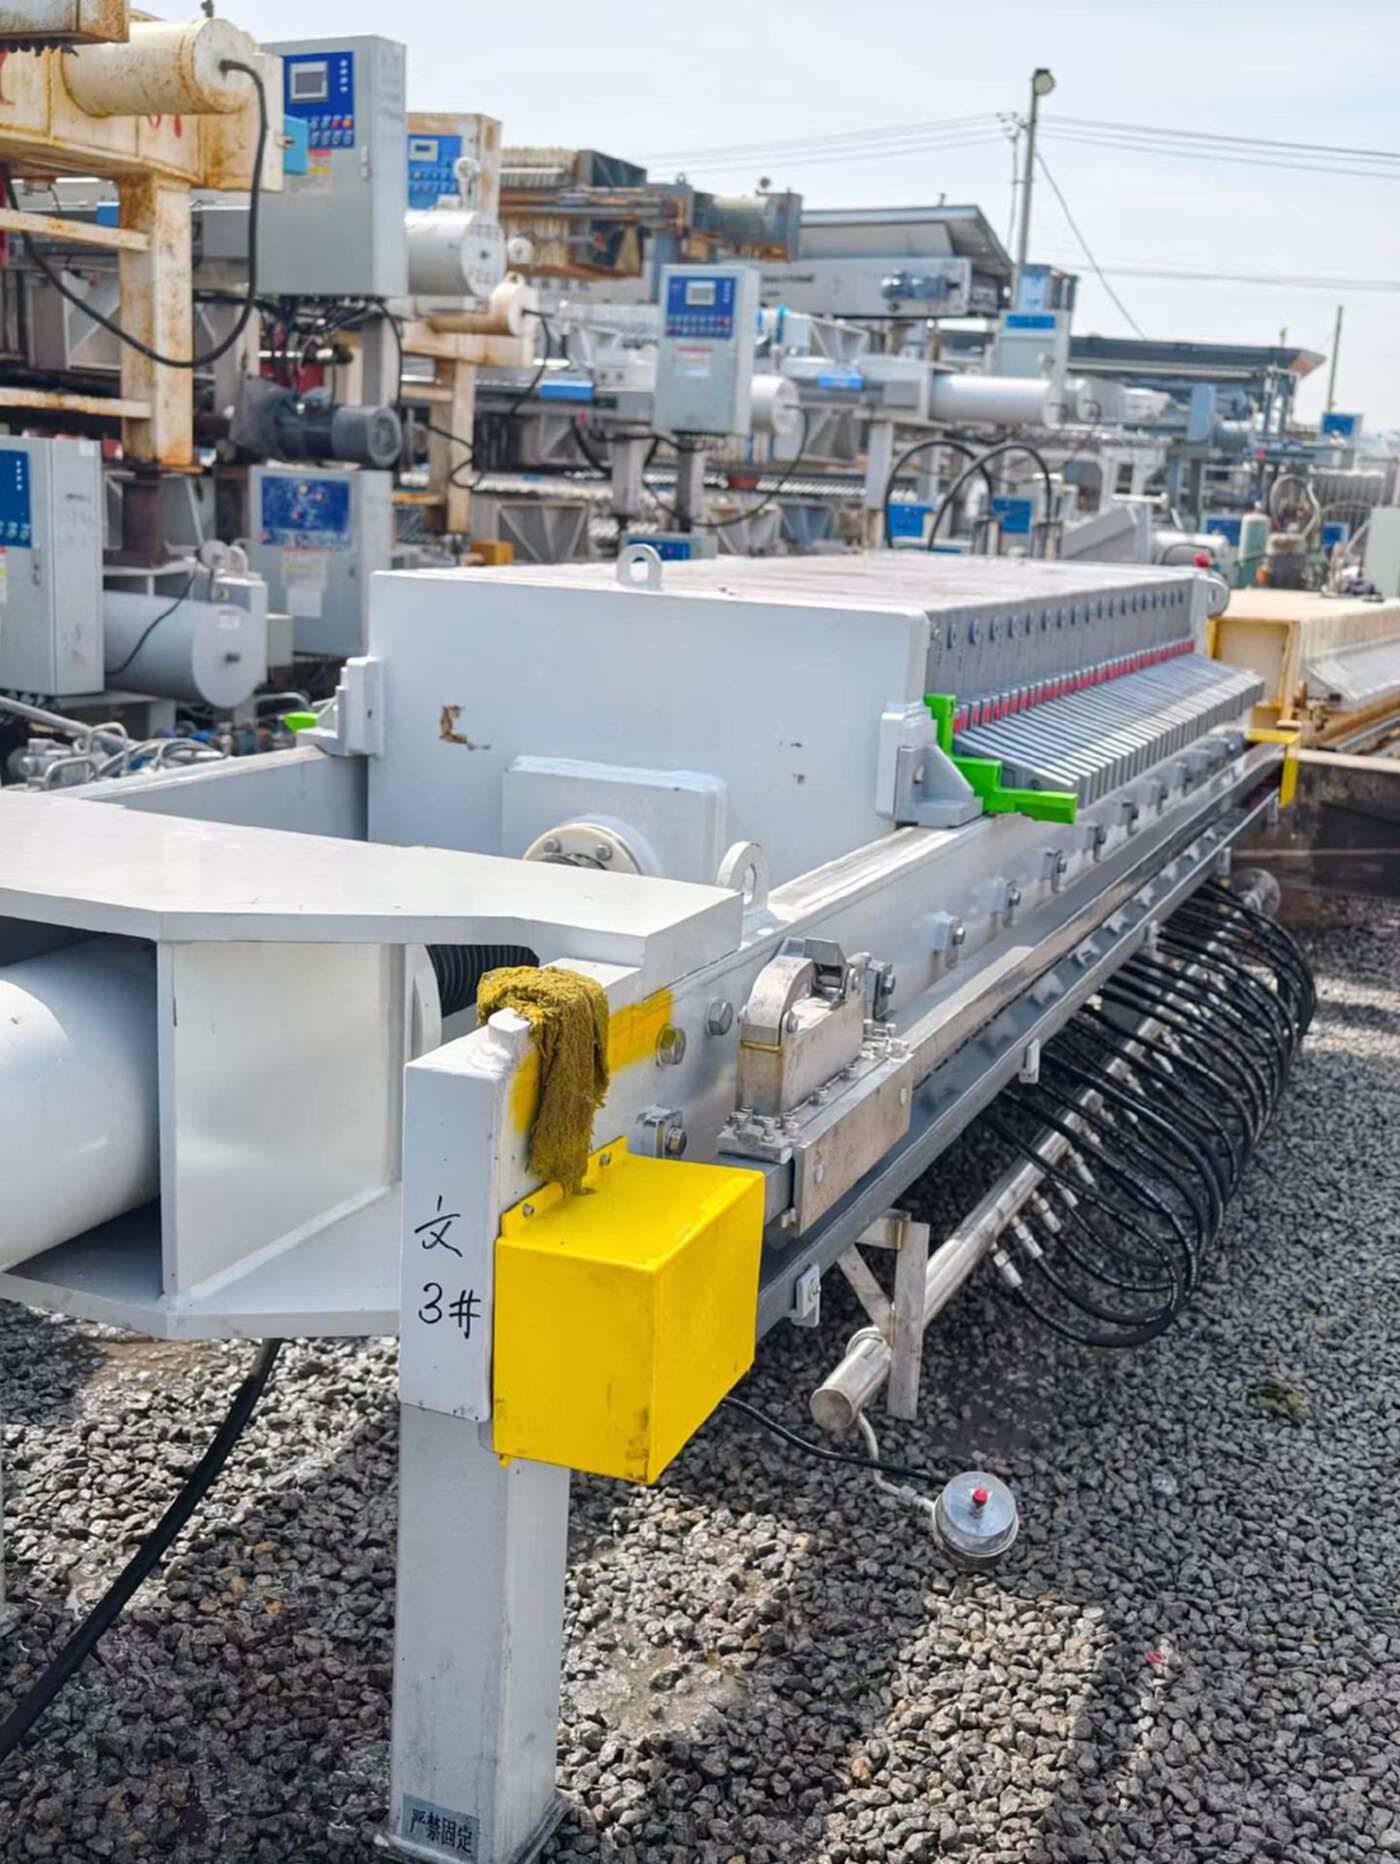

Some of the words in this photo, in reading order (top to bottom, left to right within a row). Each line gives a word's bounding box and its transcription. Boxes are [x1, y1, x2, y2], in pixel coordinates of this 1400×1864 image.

[418, 1282, 482, 1340] 3#
[409, 1808, 473, 1854] 严禁固定
